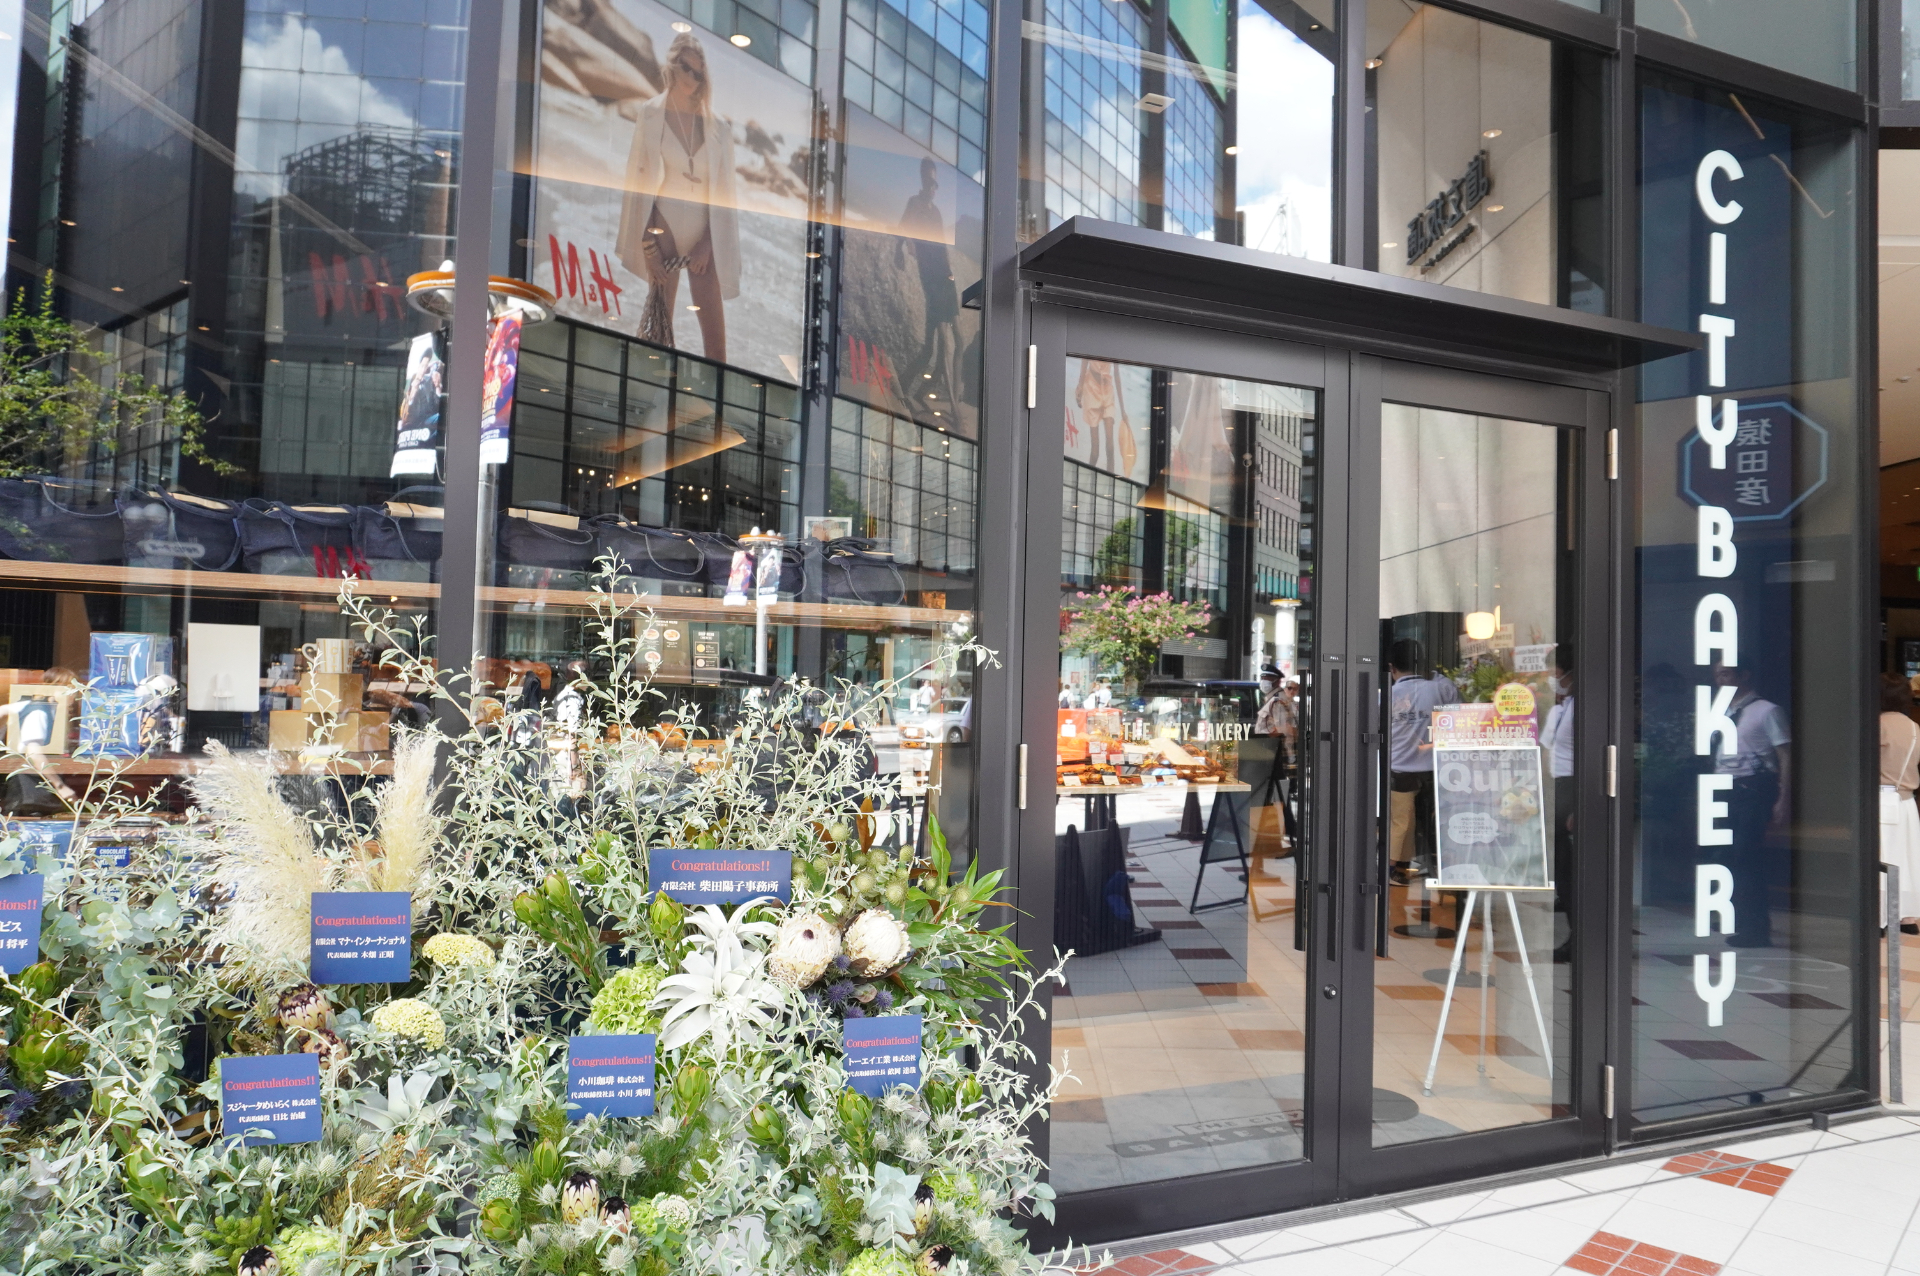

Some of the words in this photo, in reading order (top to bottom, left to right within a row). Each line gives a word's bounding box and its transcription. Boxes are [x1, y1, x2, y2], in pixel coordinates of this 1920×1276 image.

[1696, 149, 1745, 470] CITY
[1197, 722, 1252, 741] BAKERY
[1440, 751, 1537, 762] DOUGENZAKA
[1694, 504, 1739, 1027] BAKERY
[1439, 762, 1538, 794] Quiz
[671, 859, 771, 873] Congratulations!!
[660, 881, 696, 891] 有限会社
[699, 880, 779, 893] 柴田陽子事務所
[314, 914, 407, 927] Congratulations!!
[315, 938, 336, 946] 有限会社
[337, 936, 407, 946] マナ・インターナショナル
[326, 951, 358, 959] 代表取締役
[846, 1035, 919, 1048] Congratulations!!
[572, 1054, 652, 1067] Congratulations!!
[848, 1055, 891, 1066] トーエイ工業
[892, 1054, 917, 1062] 株式会社
[225, 1075, 315, 1091] Congratulations!!
[578, 1075, 615, 1087] 小川珈琲
[616, 1075, 646, 1084] 株式会社
[571, 1090, 615, 1099] 代表取締役社長
[617, 1089, 633, 1098] 小川
[226, 1099, 290, 1113] スジャータめいらく
[291, 1098, 317, 1107] 株式会社
[238, 1114, 270, 1123] 代表取締役
[272, 1112, 289, 1121] 日比
